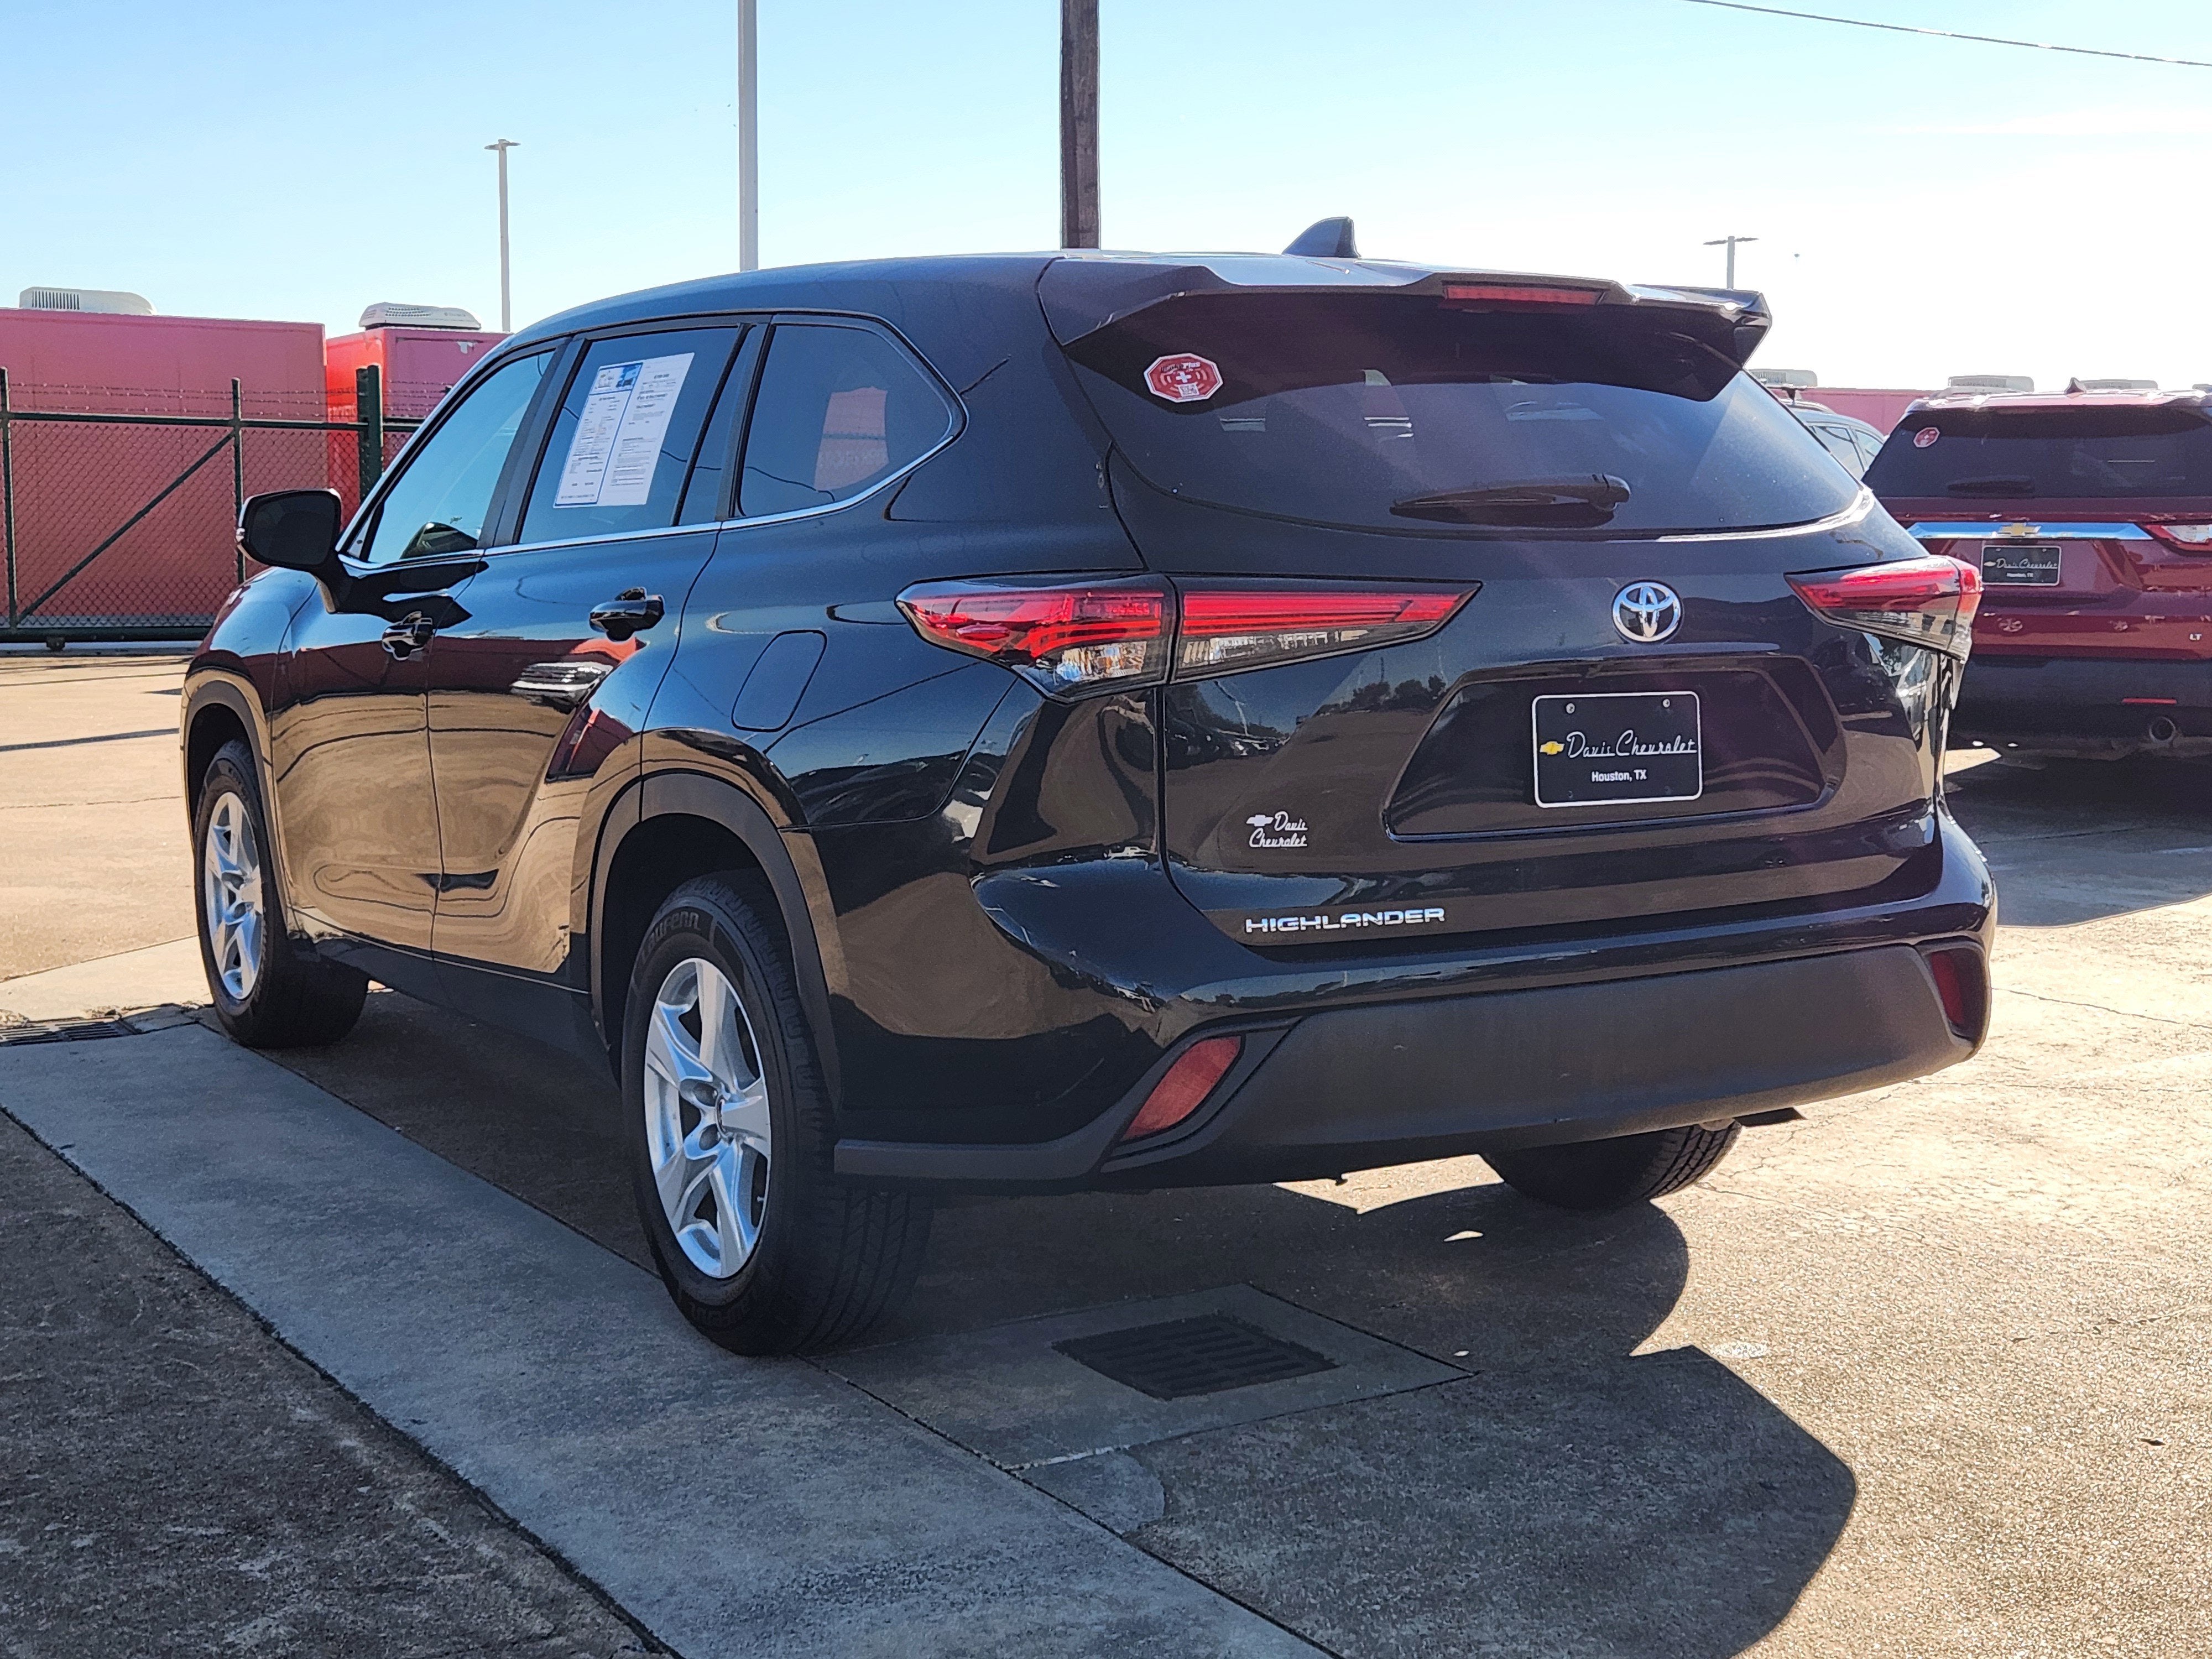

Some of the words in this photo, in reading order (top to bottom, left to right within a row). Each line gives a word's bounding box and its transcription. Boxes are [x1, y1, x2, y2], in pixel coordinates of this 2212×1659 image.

[1566, 732, 1616, 758] Davis
[1615, 729, 1697, 757] Chevrolet
[1591, 771, 1632, 782] Houston,
[1634, 769, 1647, 780] TX
[1274, 811, 1308, 831] Davis
[1249, 828, 1307, 848] Chevrolet
[1245, 907, 1445, 933] HIGHLANDER
